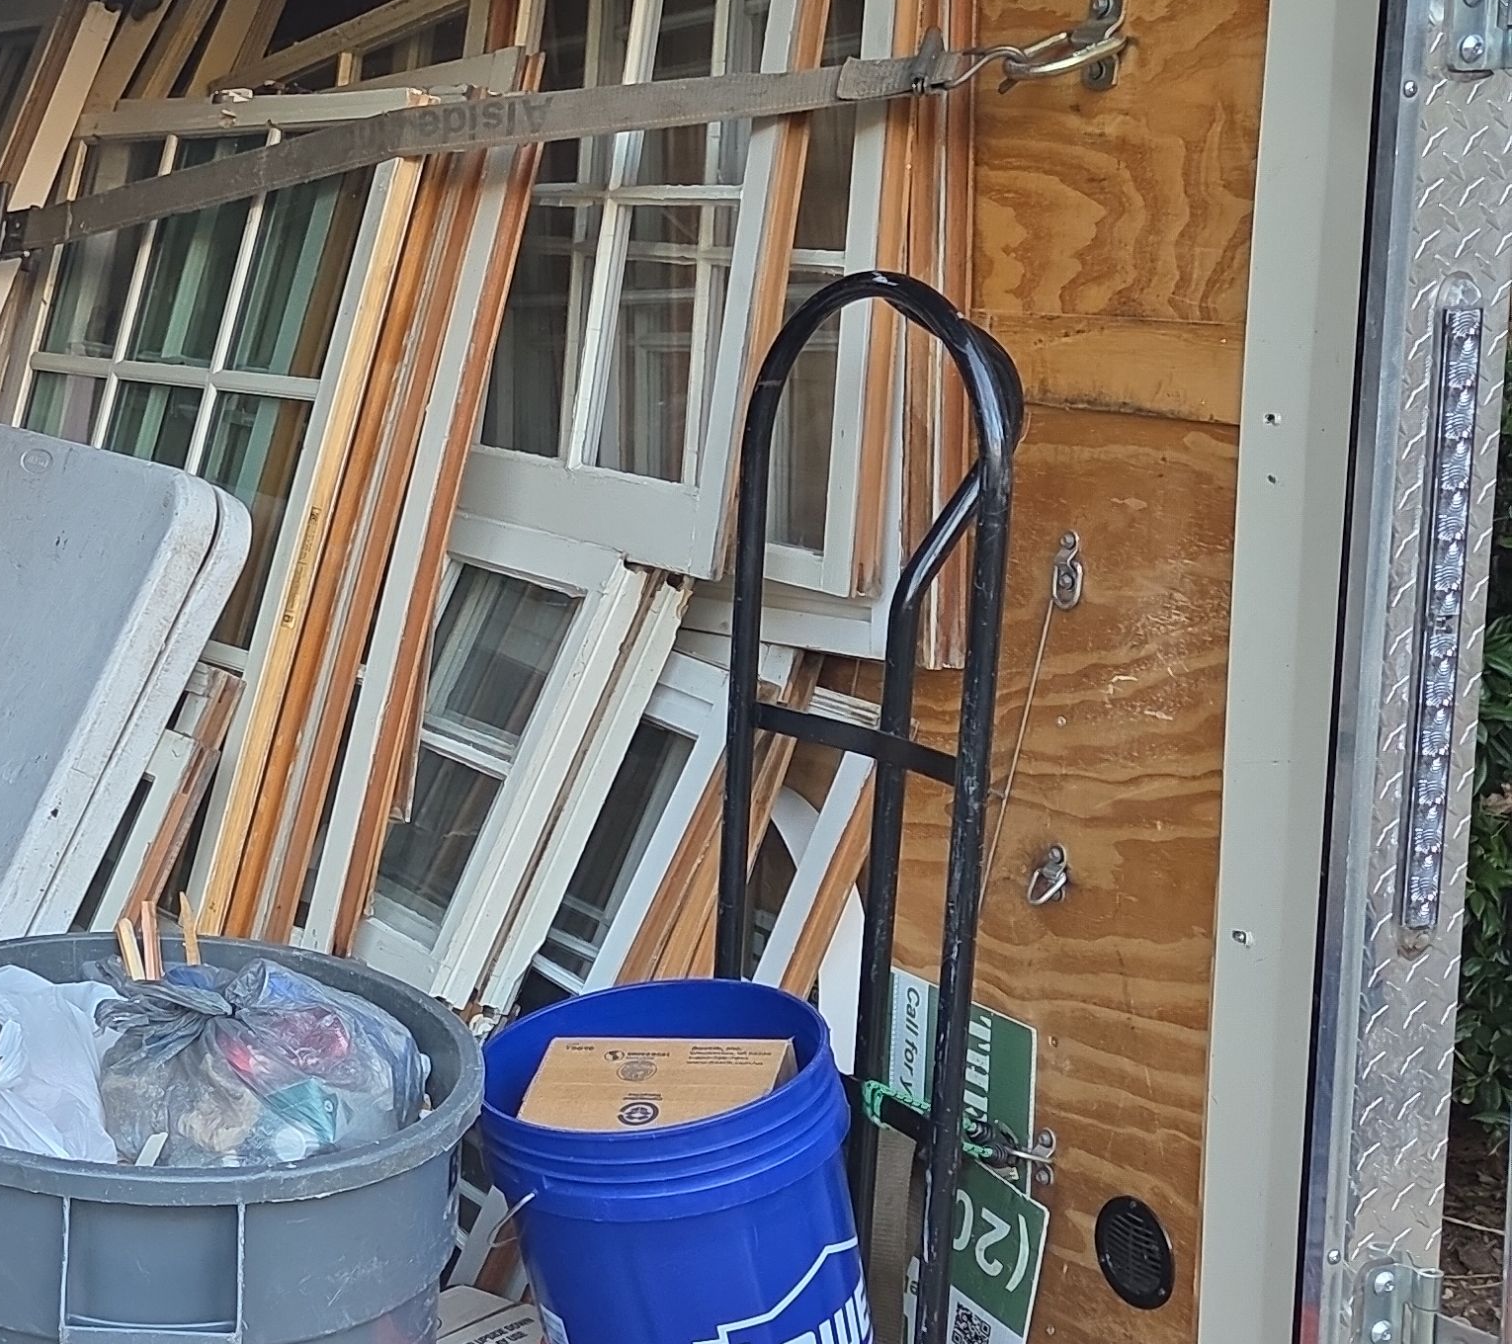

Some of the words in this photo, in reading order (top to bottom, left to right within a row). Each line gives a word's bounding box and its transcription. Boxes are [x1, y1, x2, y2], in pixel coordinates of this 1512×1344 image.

[418, 96, 554, 138] Alside
[904, 986, 921, 1036] Call
[904, 1039, 919, 1077] for
